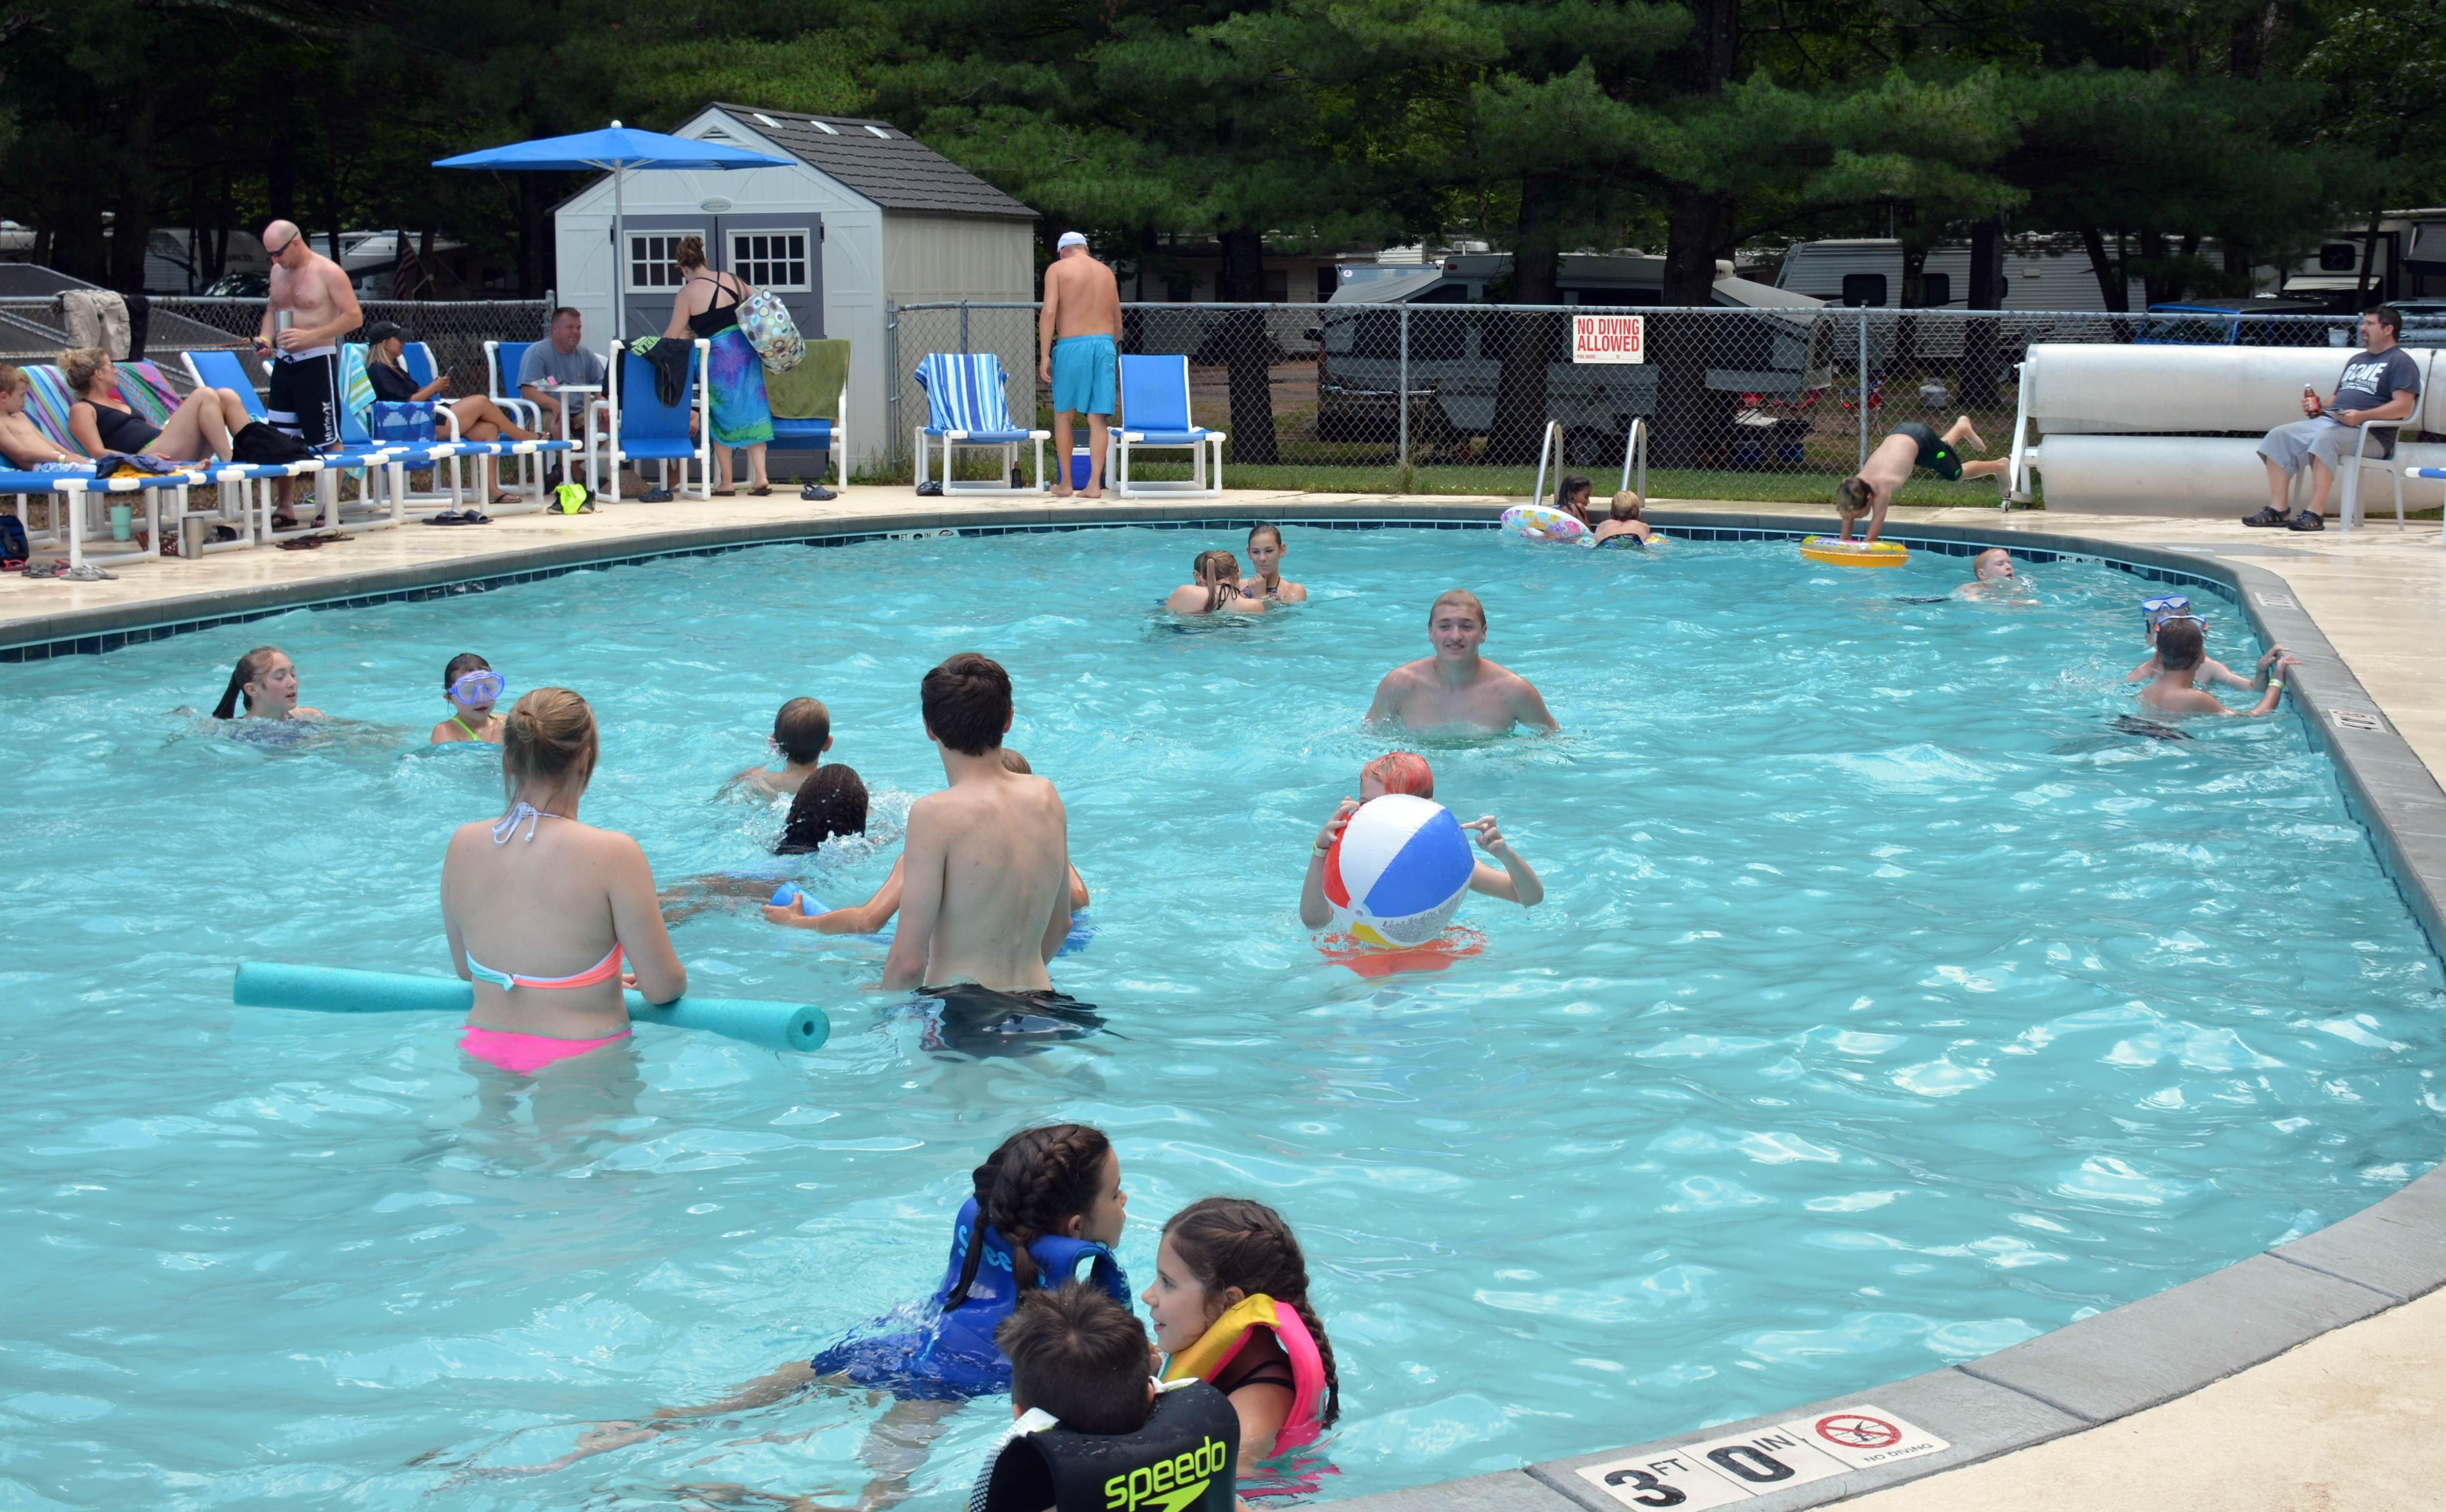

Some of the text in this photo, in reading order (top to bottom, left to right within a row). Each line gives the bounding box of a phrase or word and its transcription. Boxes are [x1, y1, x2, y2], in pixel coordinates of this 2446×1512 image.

[1577, 318, 1639, 335] NO DIVING
[1577, 335, 1640, 352] ALLOWED
[2342, 363, 2388, 382] GONE
[324, 412, 333, 441] Hurley
[1863, 1443, 1934, 1463] NO DIVING
[1105, 1436, 1226, 1512] speedo
[1604, 1434, 1797, 1507] 3 FT 0 IN
